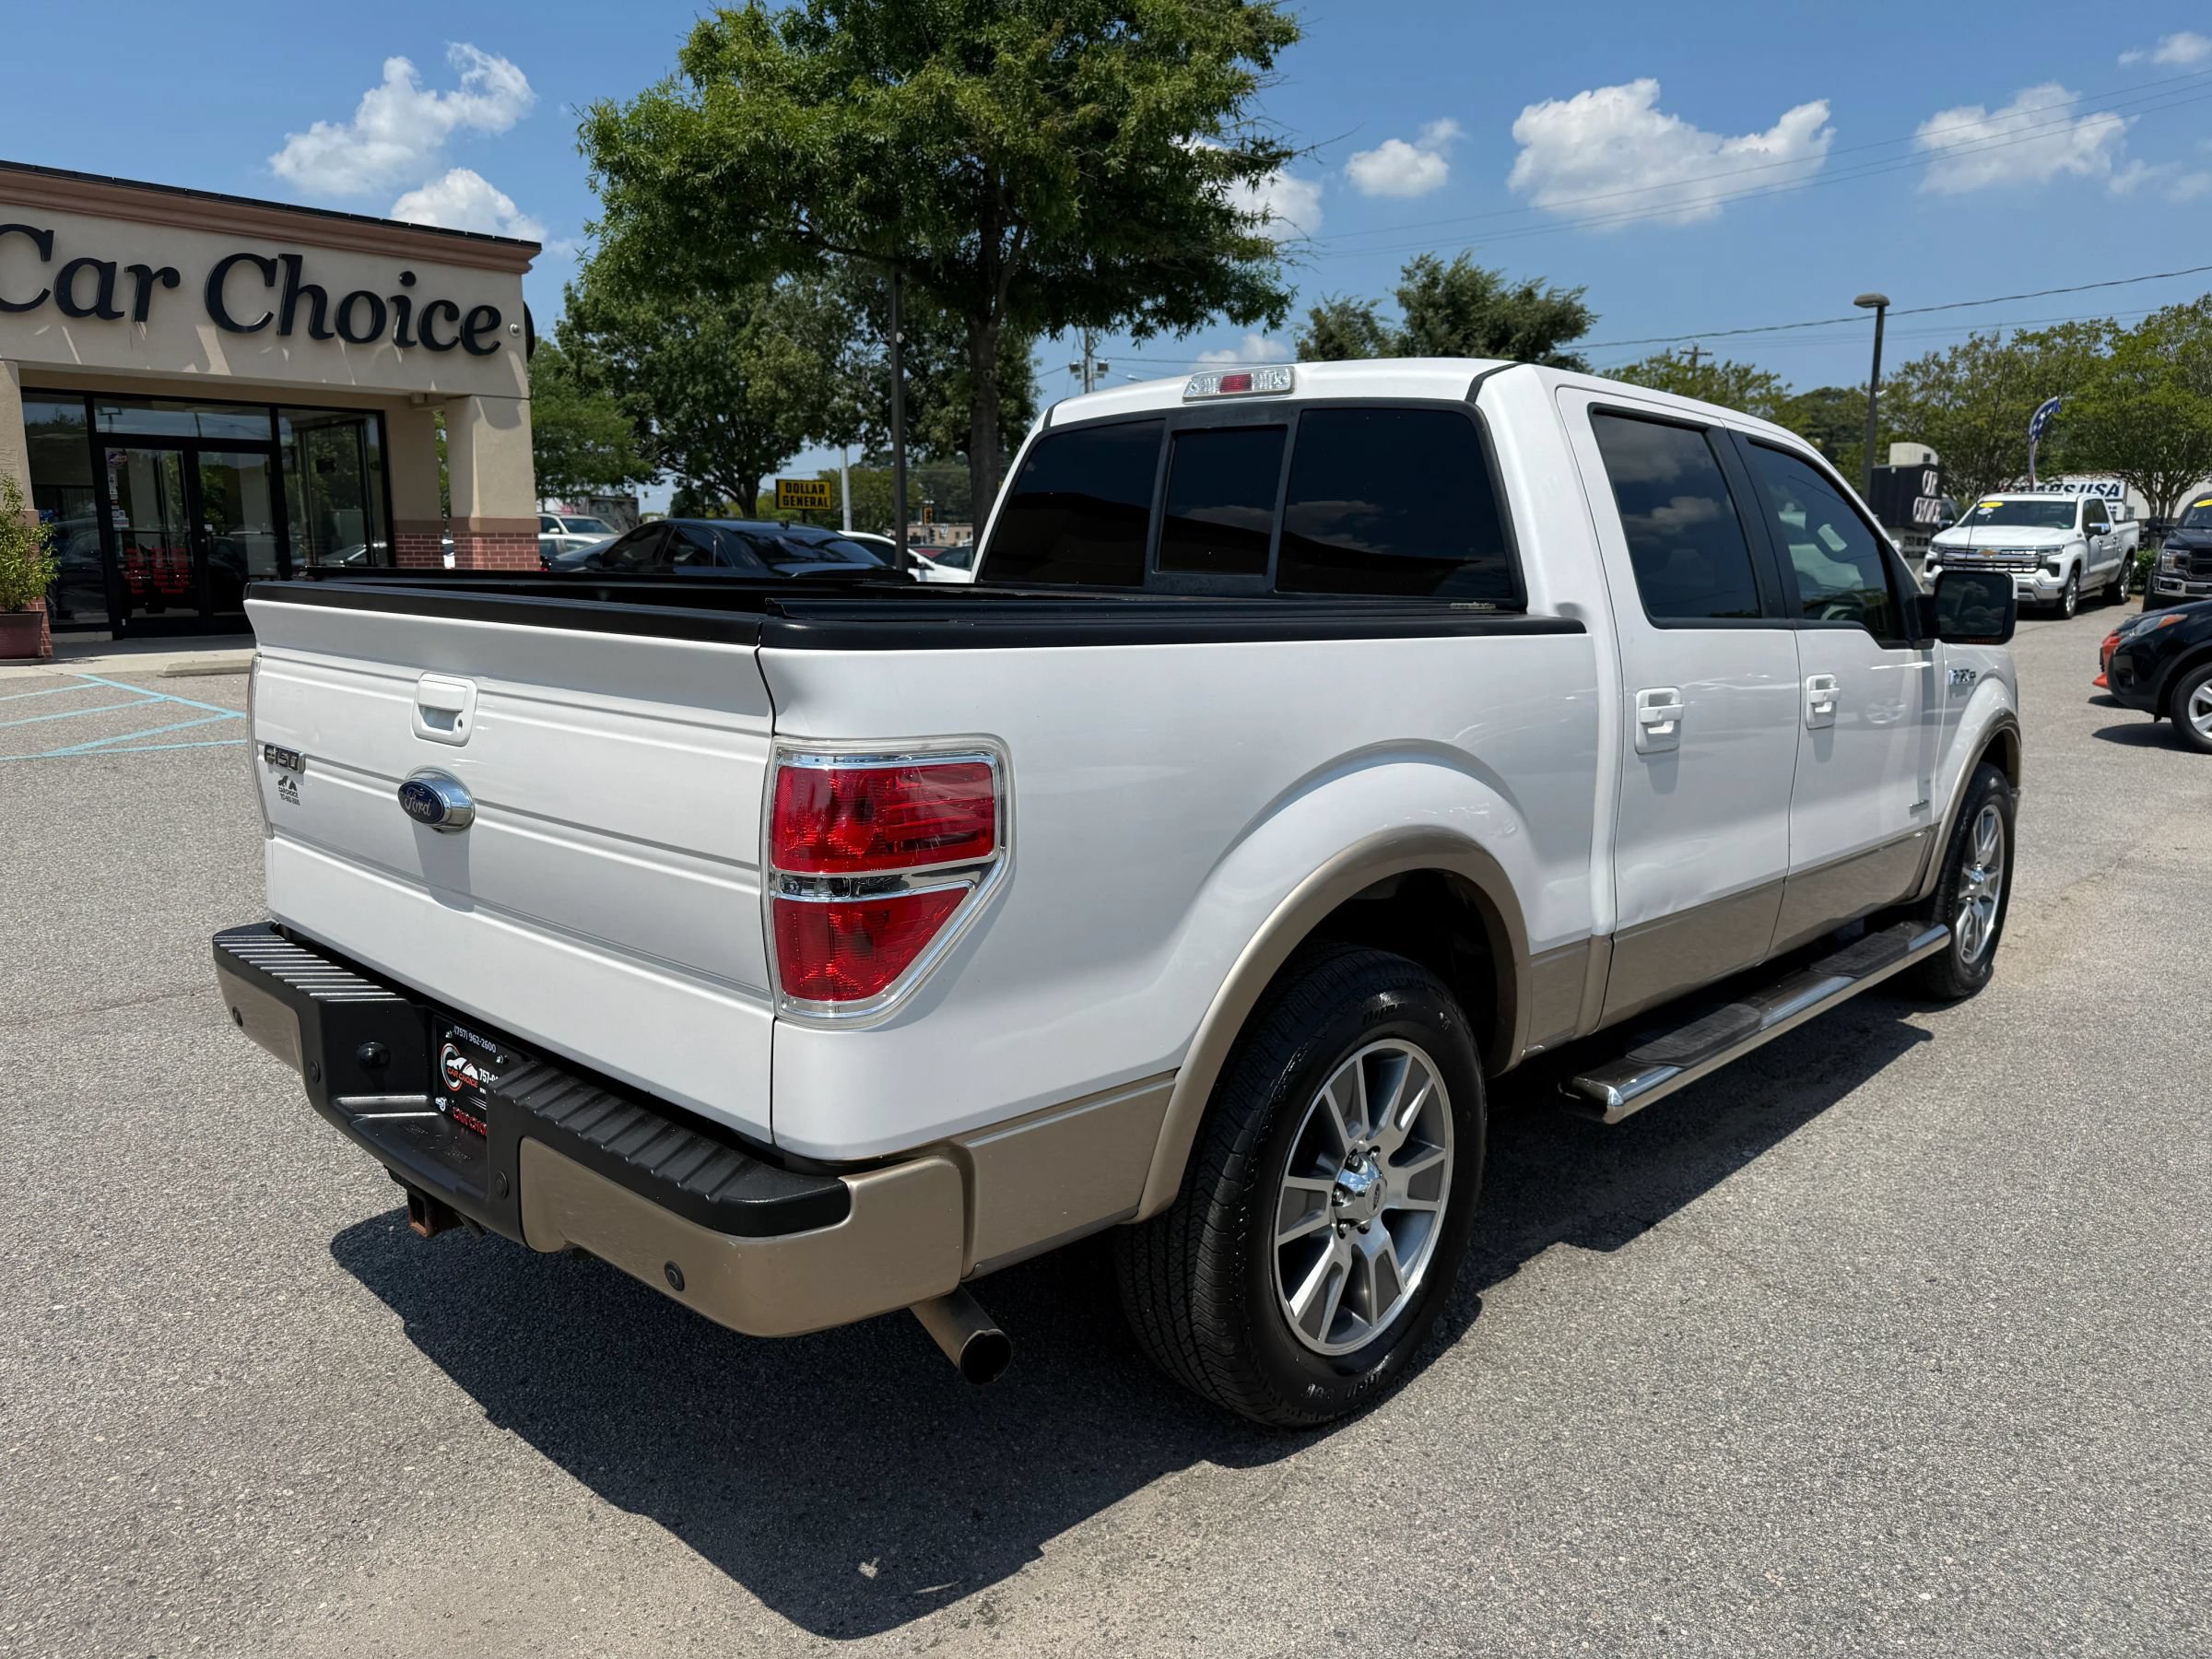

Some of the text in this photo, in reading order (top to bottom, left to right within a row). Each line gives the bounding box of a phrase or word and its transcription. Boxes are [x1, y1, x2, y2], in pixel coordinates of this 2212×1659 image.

[0, 223, 502, 356] Car Choice
[785, 482, 825, 495] DOLLAR
[782, 495, 829, 508] GENERAL
[404, 786, 432, 817] Ford
[453, 1025, 497, 1053] (757) 962-2600
[447, 1066, 478, 1088] CAR CHOICE
